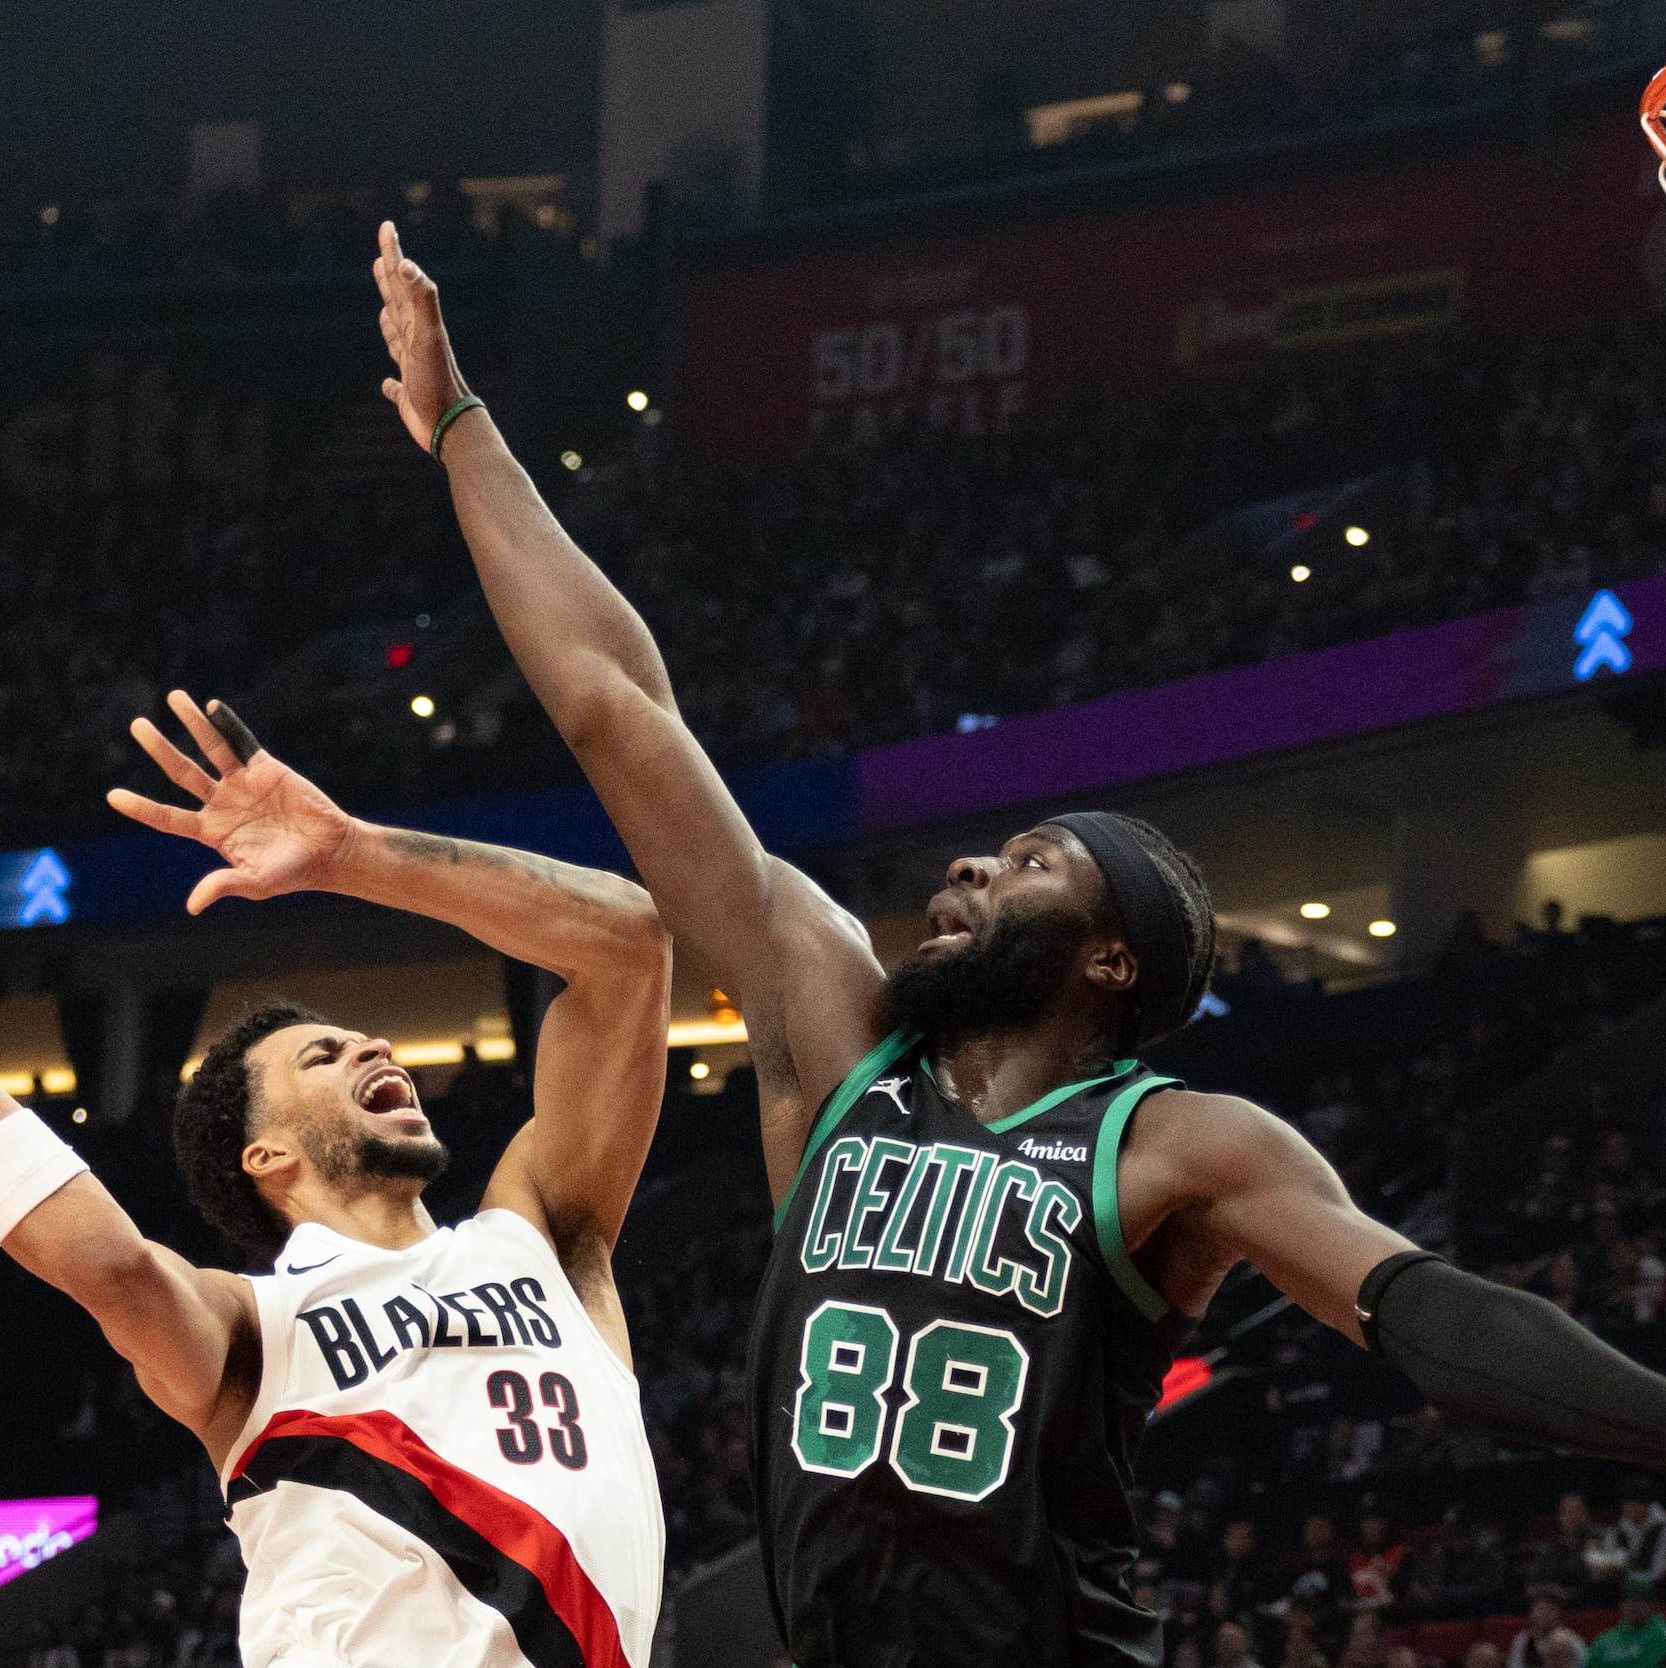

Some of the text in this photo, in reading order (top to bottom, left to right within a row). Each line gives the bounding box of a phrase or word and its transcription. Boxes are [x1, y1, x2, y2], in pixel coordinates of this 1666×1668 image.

[811, 304, 1030, 402] 50/50
[1017, 1138, 1087, 1162] Amica
[801, 1137, 1082, 1318] CELTICS
[296, 1276, 563, 1391] BLAZERS
[486, 1370, 589, 1471] 33
[791, 1300, 1030, 1502] 88
